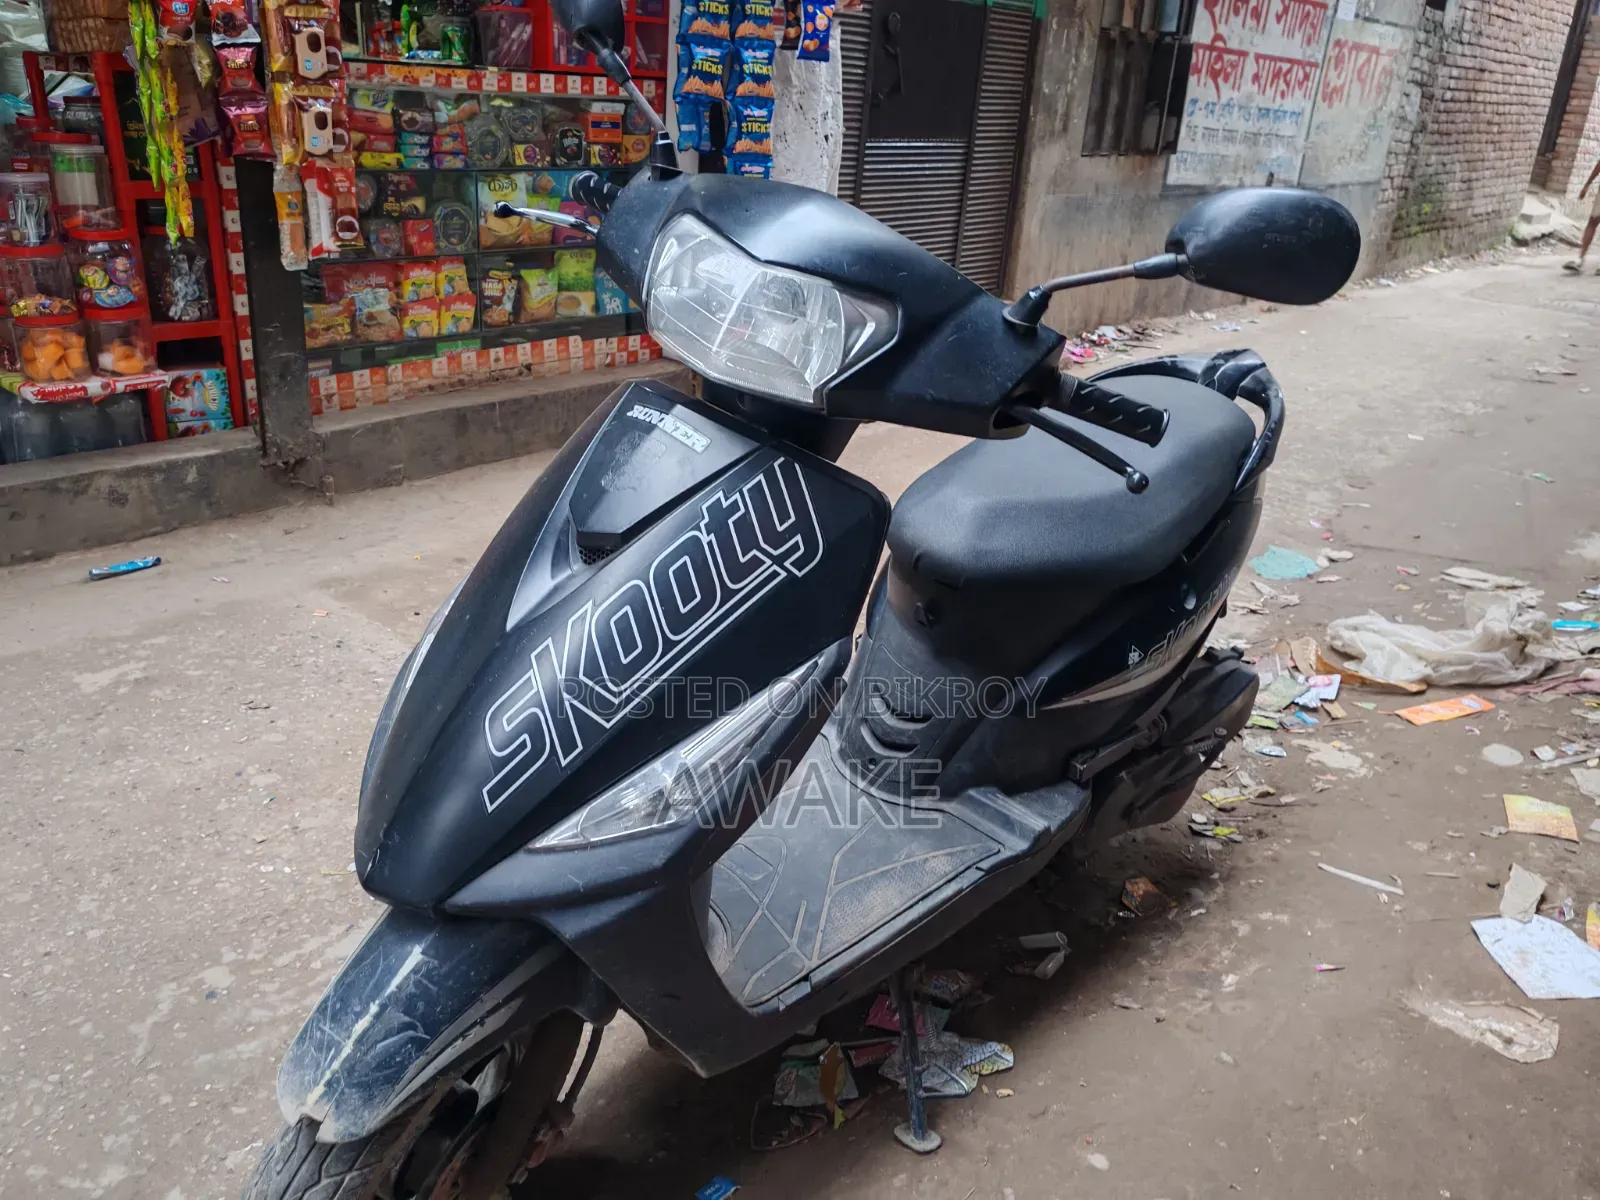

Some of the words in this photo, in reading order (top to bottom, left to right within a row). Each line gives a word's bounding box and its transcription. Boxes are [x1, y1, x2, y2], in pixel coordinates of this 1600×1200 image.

[698, 1, 729, 15] STICKS
[691, 60, 723, 75] STICKS
[742, 63, 773, 75] STICKS
[1189, 32, 1249, 104] মহিলা
[1251, 52, 1320, 104] মাদরাসা
[626, 404, 712, 455] RUNNER
